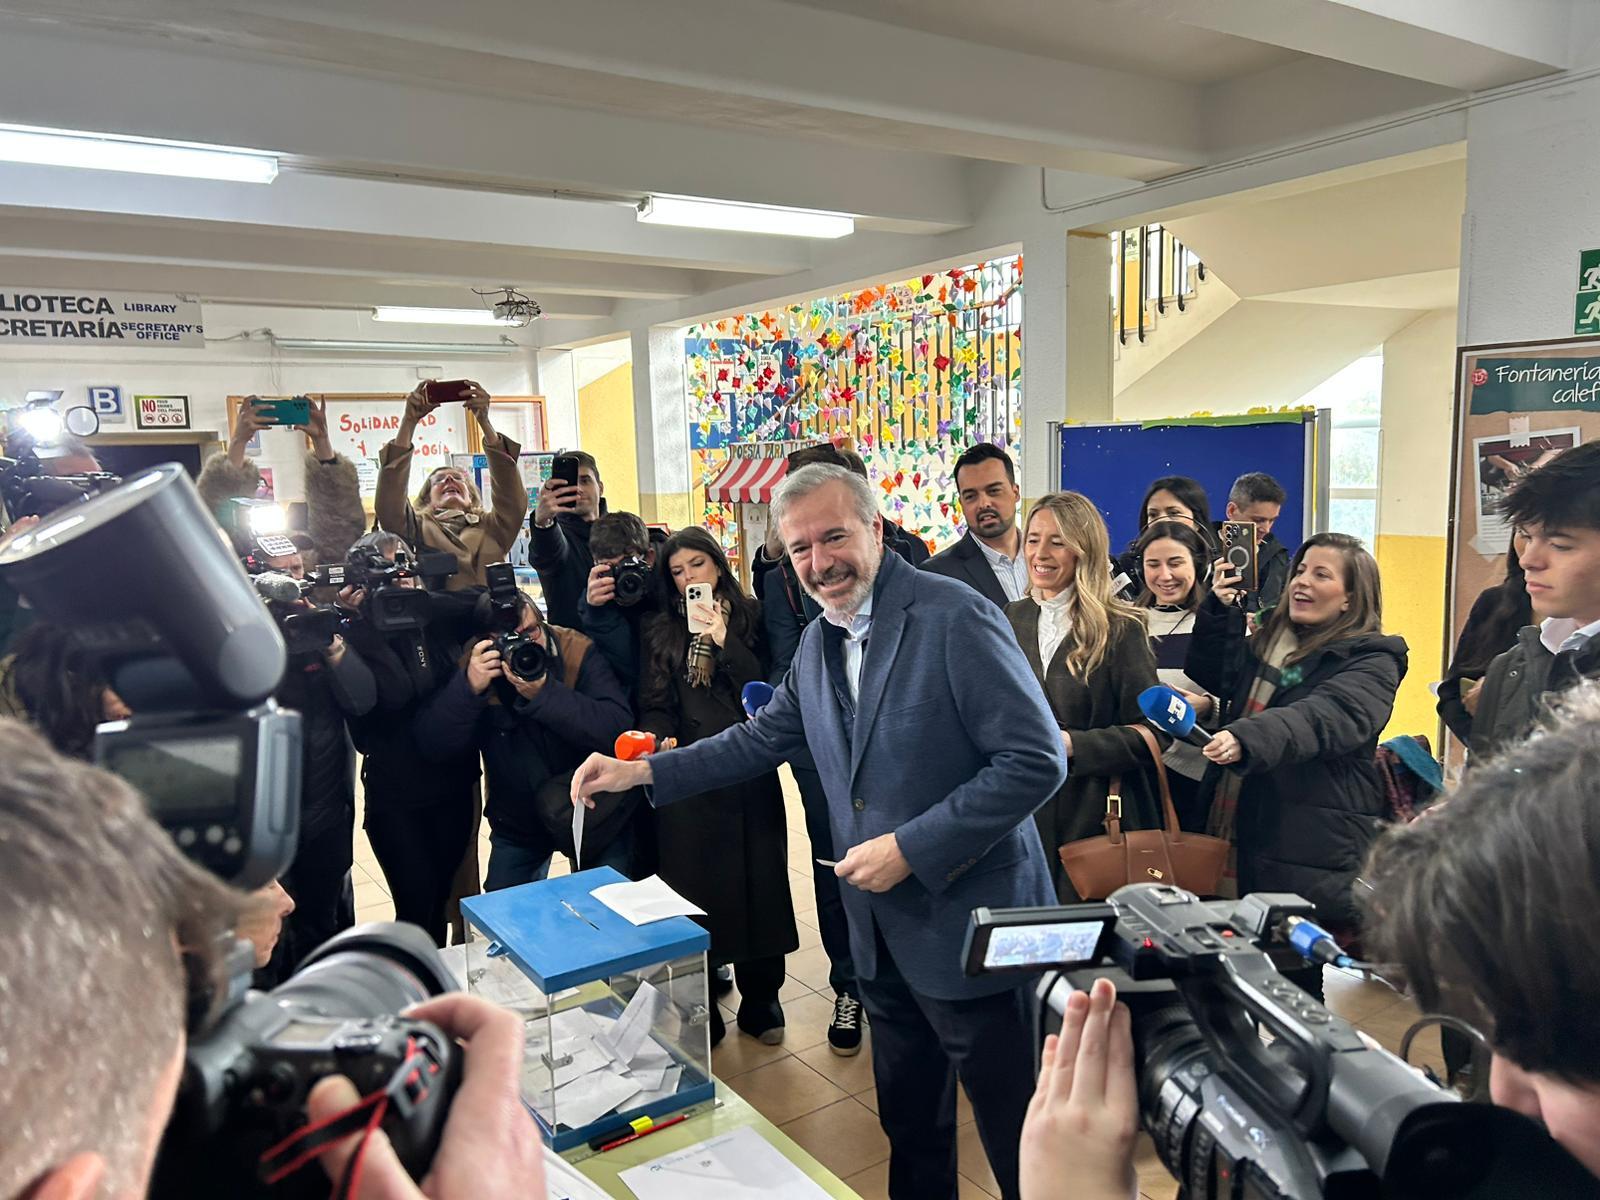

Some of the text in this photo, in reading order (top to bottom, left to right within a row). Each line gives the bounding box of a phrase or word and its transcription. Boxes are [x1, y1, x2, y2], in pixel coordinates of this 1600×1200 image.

[124, 302, 177, 313] LIBRARY
[136, 331, 180, 340] OFFICE
[1495, 361, 1600, 383] Fontanería
[93, 388, 118, 413] B
[142, 399, 156, 413] NO
[357, 440, 367, 457] Y
[764, 442, 785, 459] PARA
